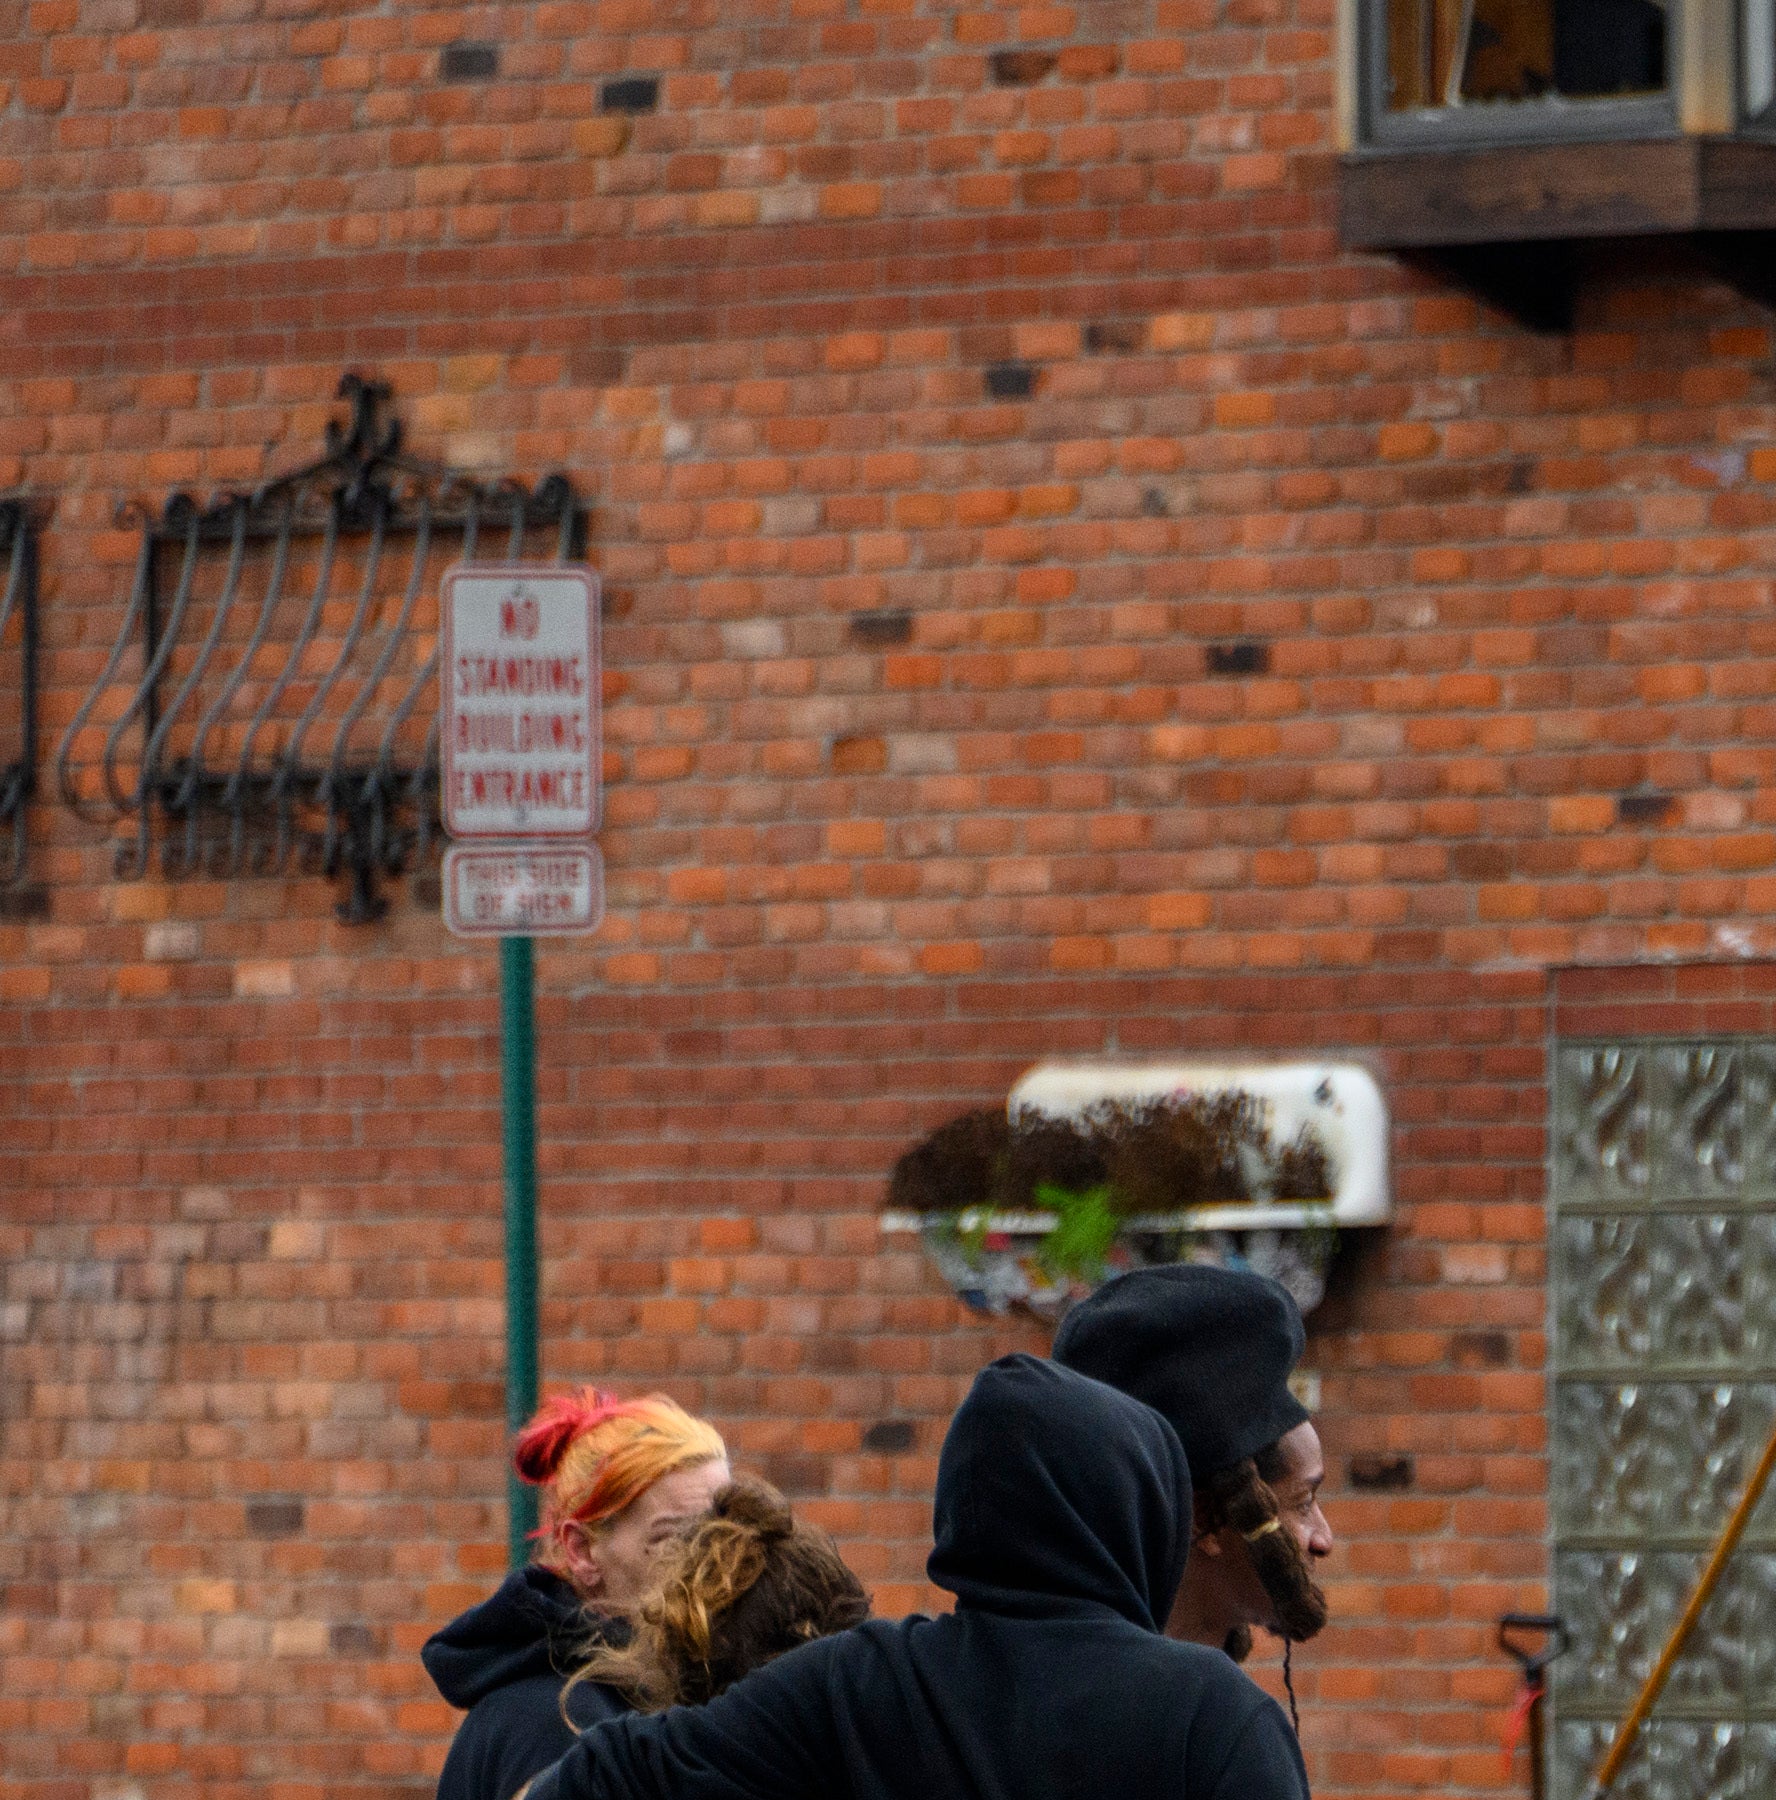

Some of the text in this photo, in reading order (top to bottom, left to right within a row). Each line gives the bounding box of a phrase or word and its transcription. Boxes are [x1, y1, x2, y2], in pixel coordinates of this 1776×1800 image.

[501, 600, 540, 639] NO
[458, 657, 583, 696] STANDING
[455, 769, 585, 810] ENTRANCE
